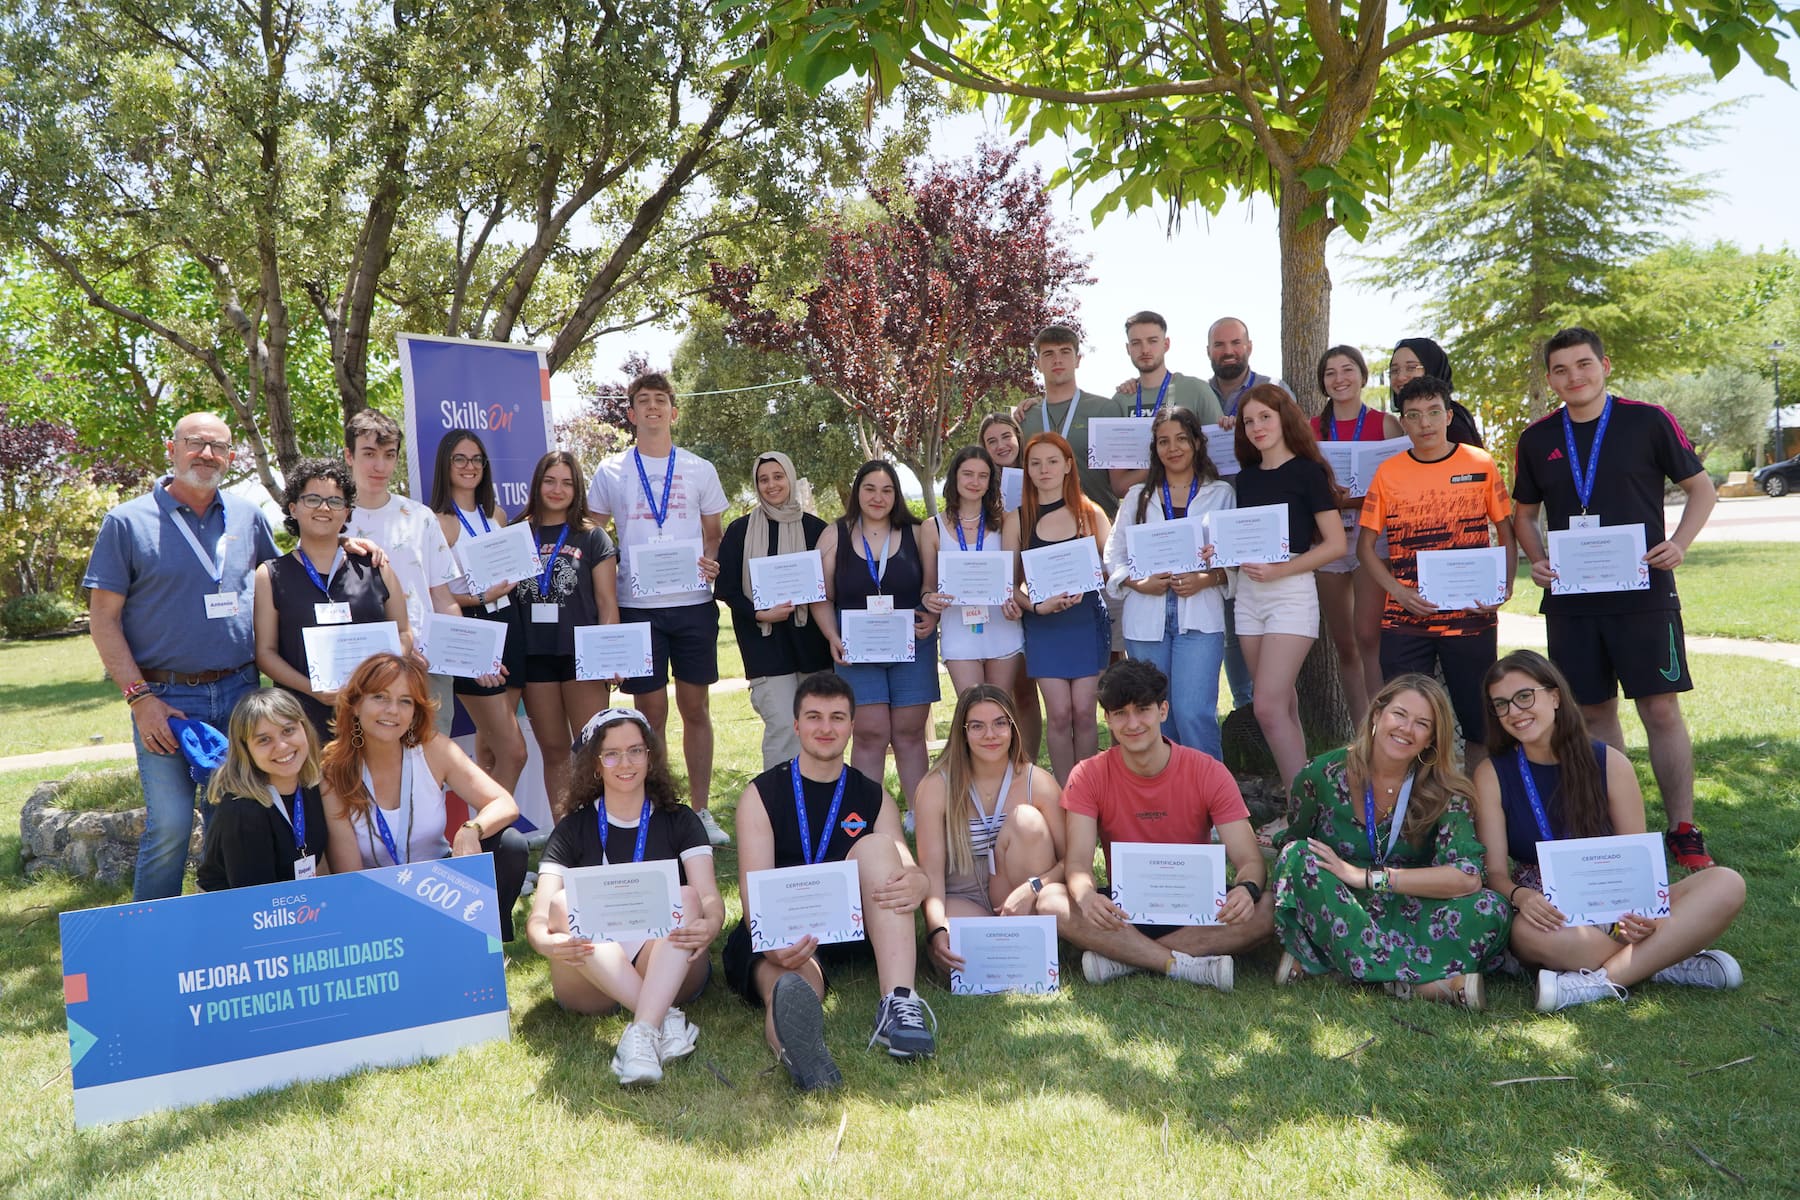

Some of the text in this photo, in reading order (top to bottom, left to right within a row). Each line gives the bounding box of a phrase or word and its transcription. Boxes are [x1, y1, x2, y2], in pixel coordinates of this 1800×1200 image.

[440, 400, 513, 432] SkillsOn
[502, 482, 529, 506] TUS
[1149, 859, 1186, 867] CERTIFICADO
[1581, 854, 1621, 862] CERTIFICADO
[603, 878, 640, 887] CERTIFICADO
[785, 880, 821, 889] CERTIFICADO
[272, 894, 307, 907] BECAS
[416, 876, 461, 910] 600
[463, 899, 484, 922] €
[252, 905, 321, 931] SkillsOn
[178, 937, 405, 994] MEJORA TUS HABILIDADES
[189, 970, 400, 1026] Y POTENCIA TU TALENTO
